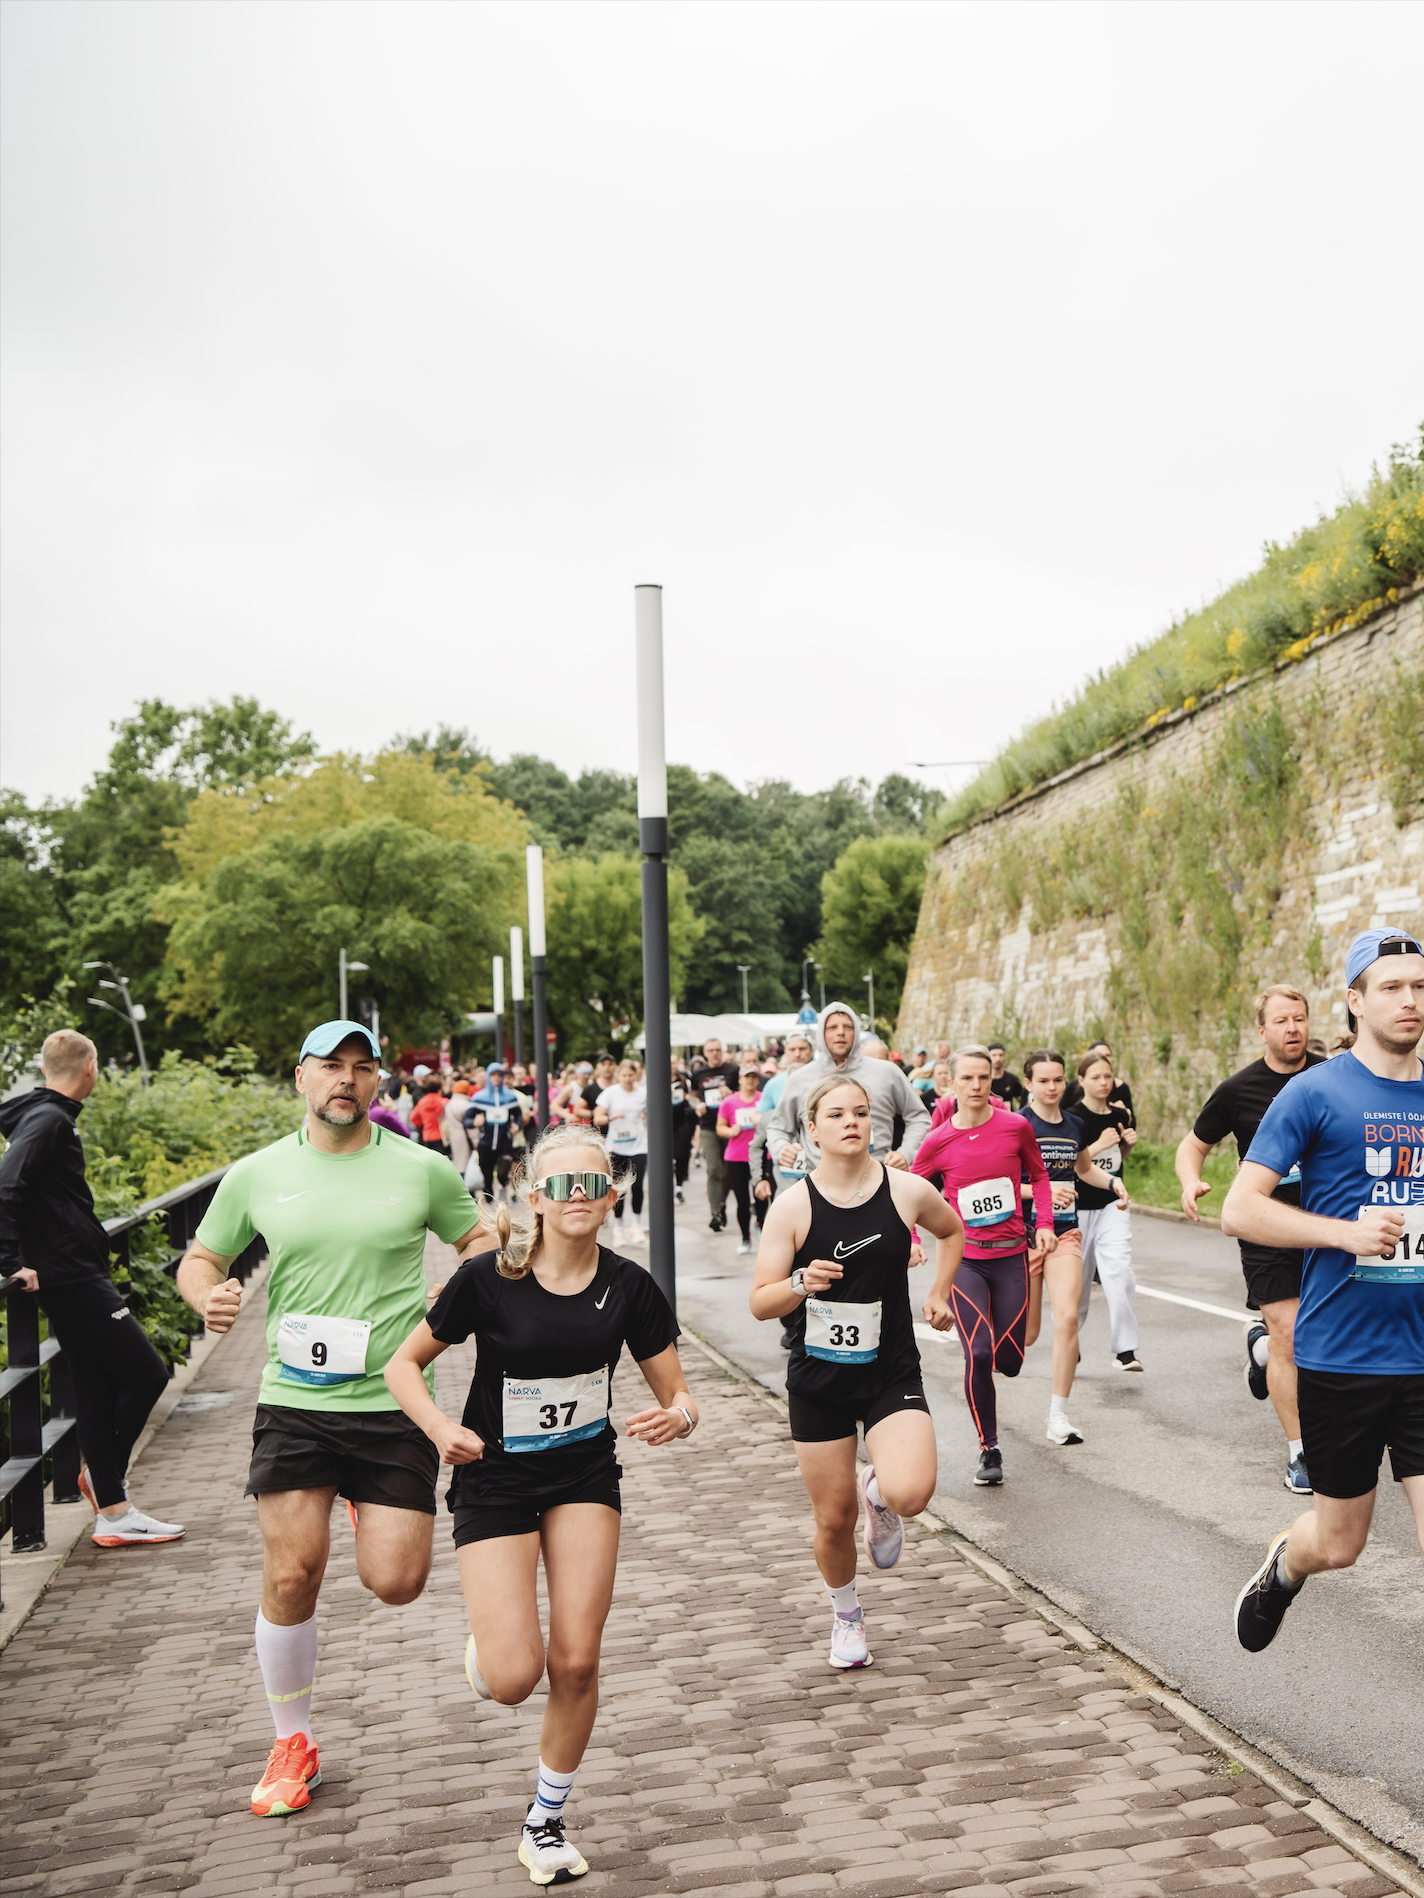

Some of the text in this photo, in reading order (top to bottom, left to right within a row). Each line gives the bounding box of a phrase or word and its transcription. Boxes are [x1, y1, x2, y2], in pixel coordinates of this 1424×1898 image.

[1363, 1111, 1402, 1120] ÜLEMISTE
[972, 1195, 1003, 1215] 885
[829, 1324, 860, 1347] 33
[311, 1342, 328, 1367] 9
[508, 1387, 542, 1396] NARVA
[539, 1400, 578, 1430] 37
